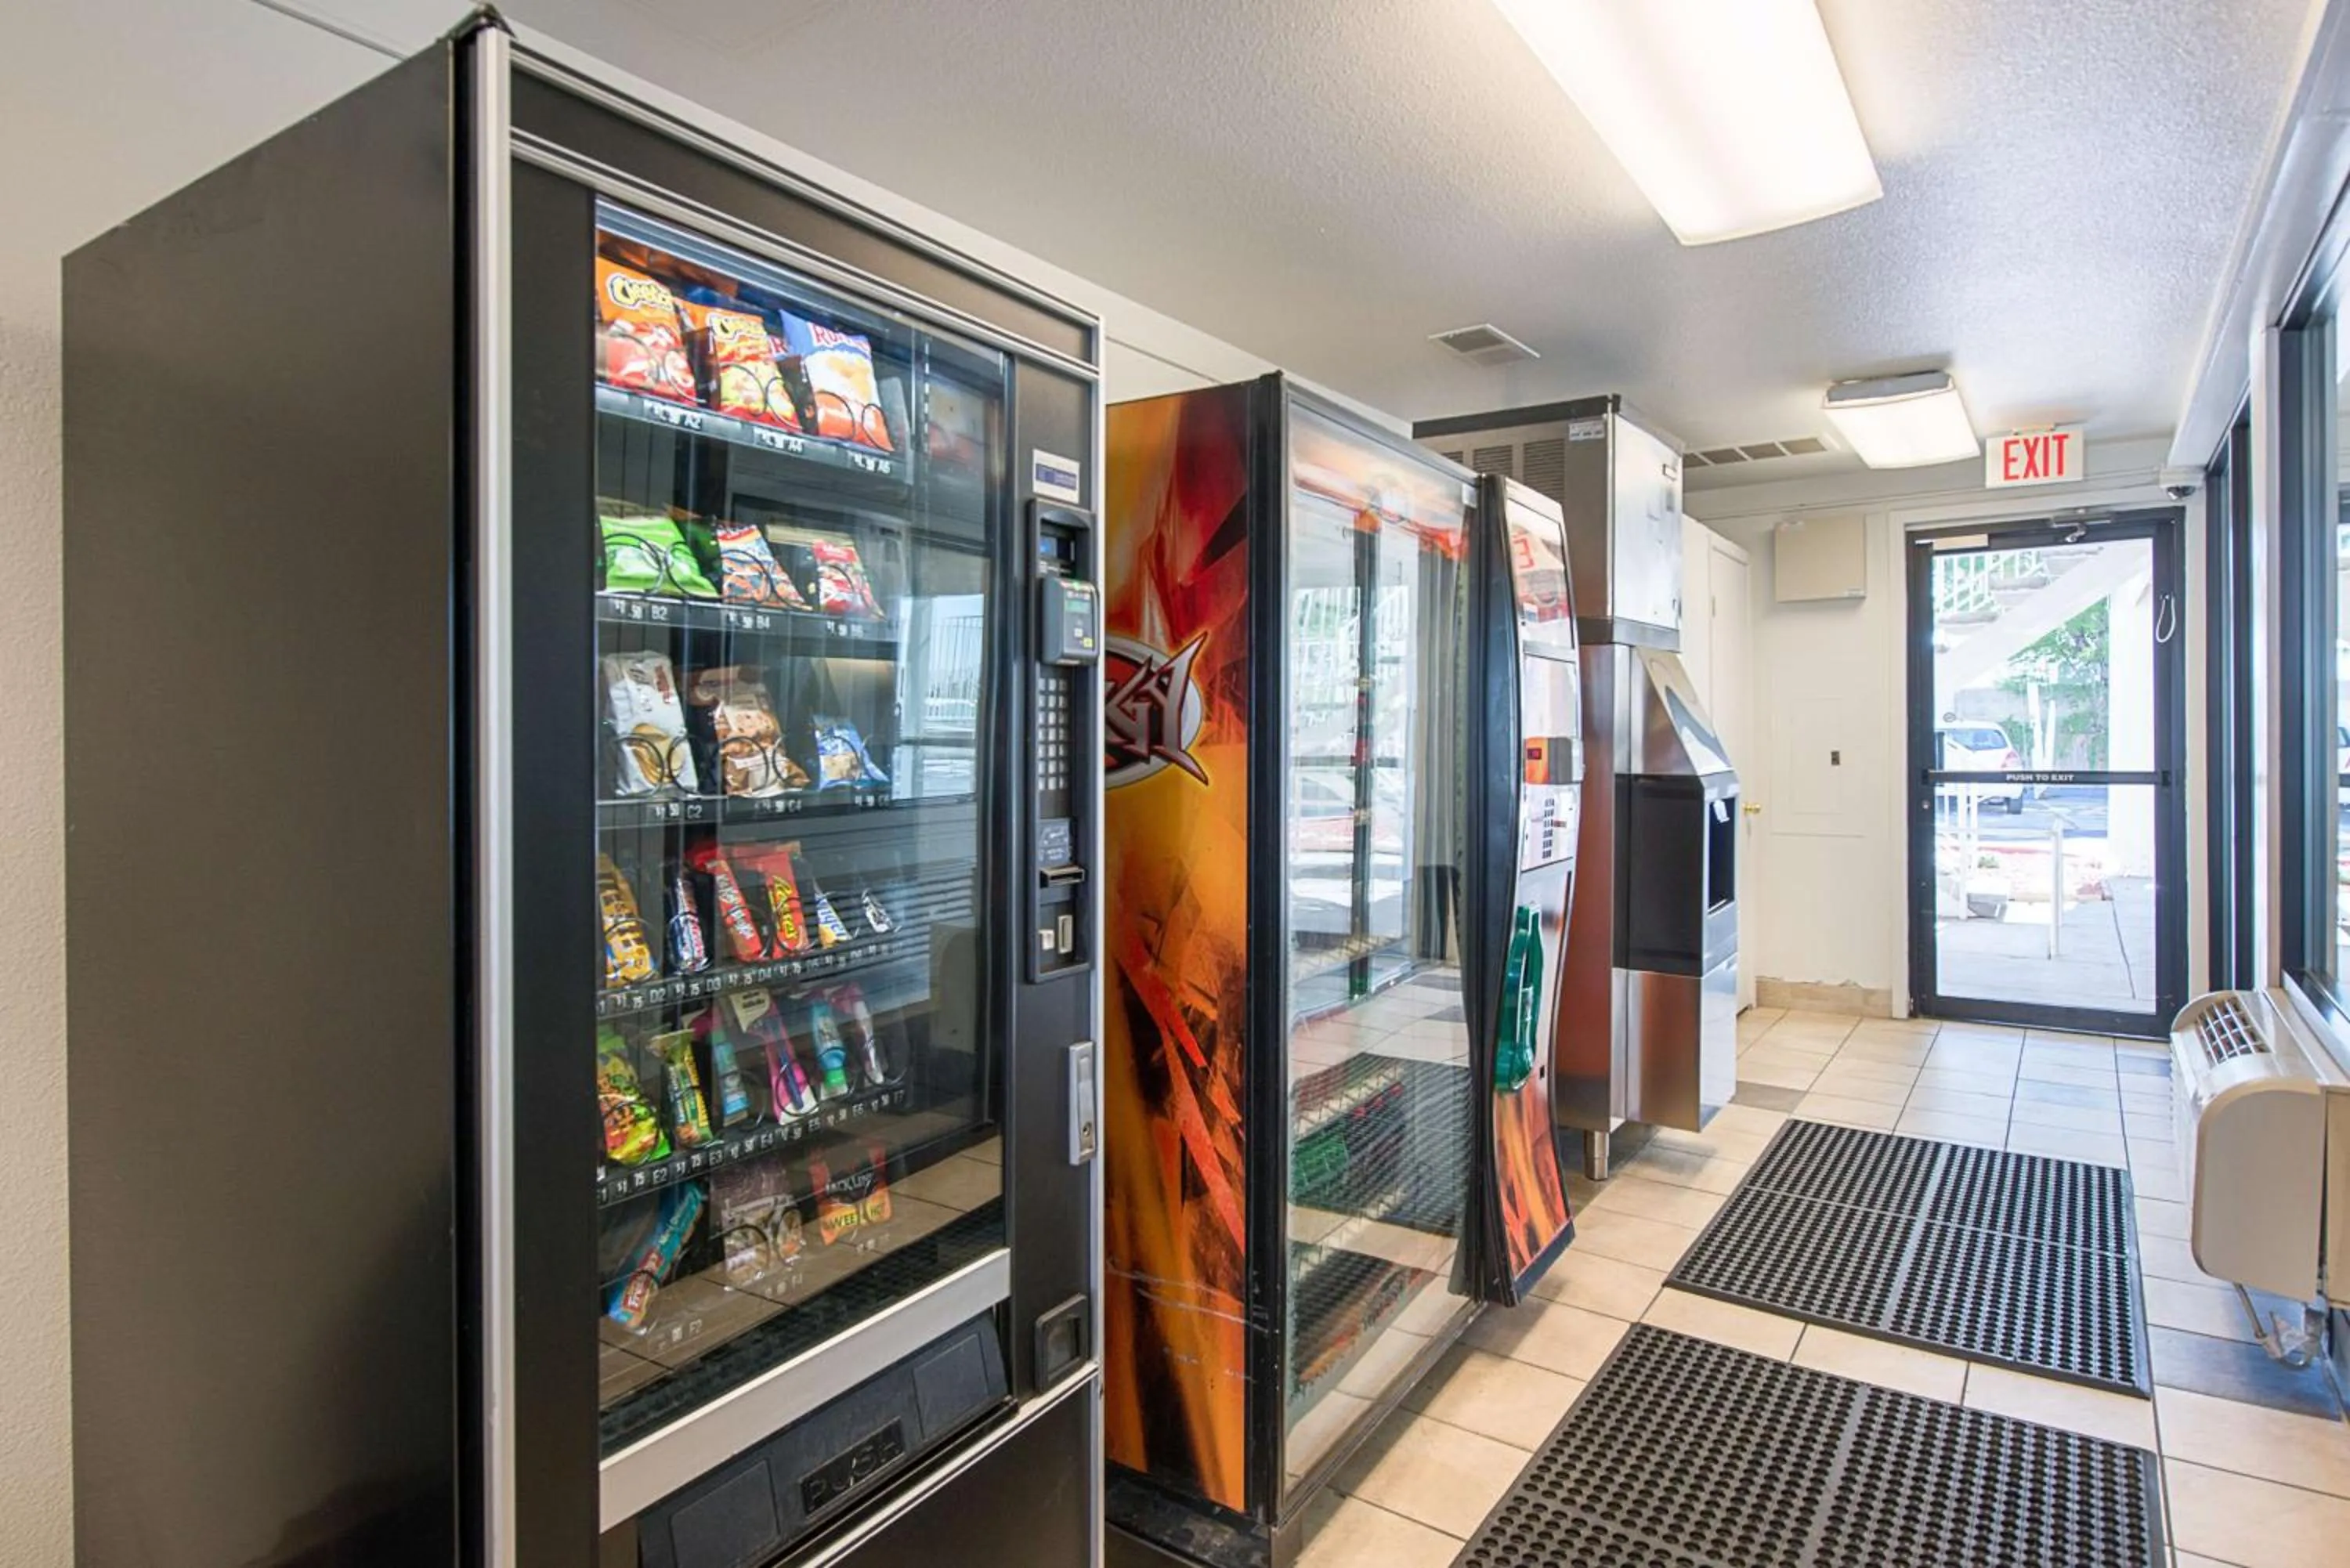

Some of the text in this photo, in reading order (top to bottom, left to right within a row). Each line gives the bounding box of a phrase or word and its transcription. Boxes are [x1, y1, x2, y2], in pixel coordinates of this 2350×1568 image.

[2003, 433, 2070, 481] EXIT
[651, 604, 668, 621] B2
[2006, 773, 2074, 782] PUSH TO EXIT
[686, 804, 703, 819] C2
[706, 977, 721, 992] D3
[649, 987, 666, 1003] D2
[708, 1149, 723, 1166] E3
[653, 1167, 668, 1184] E2
